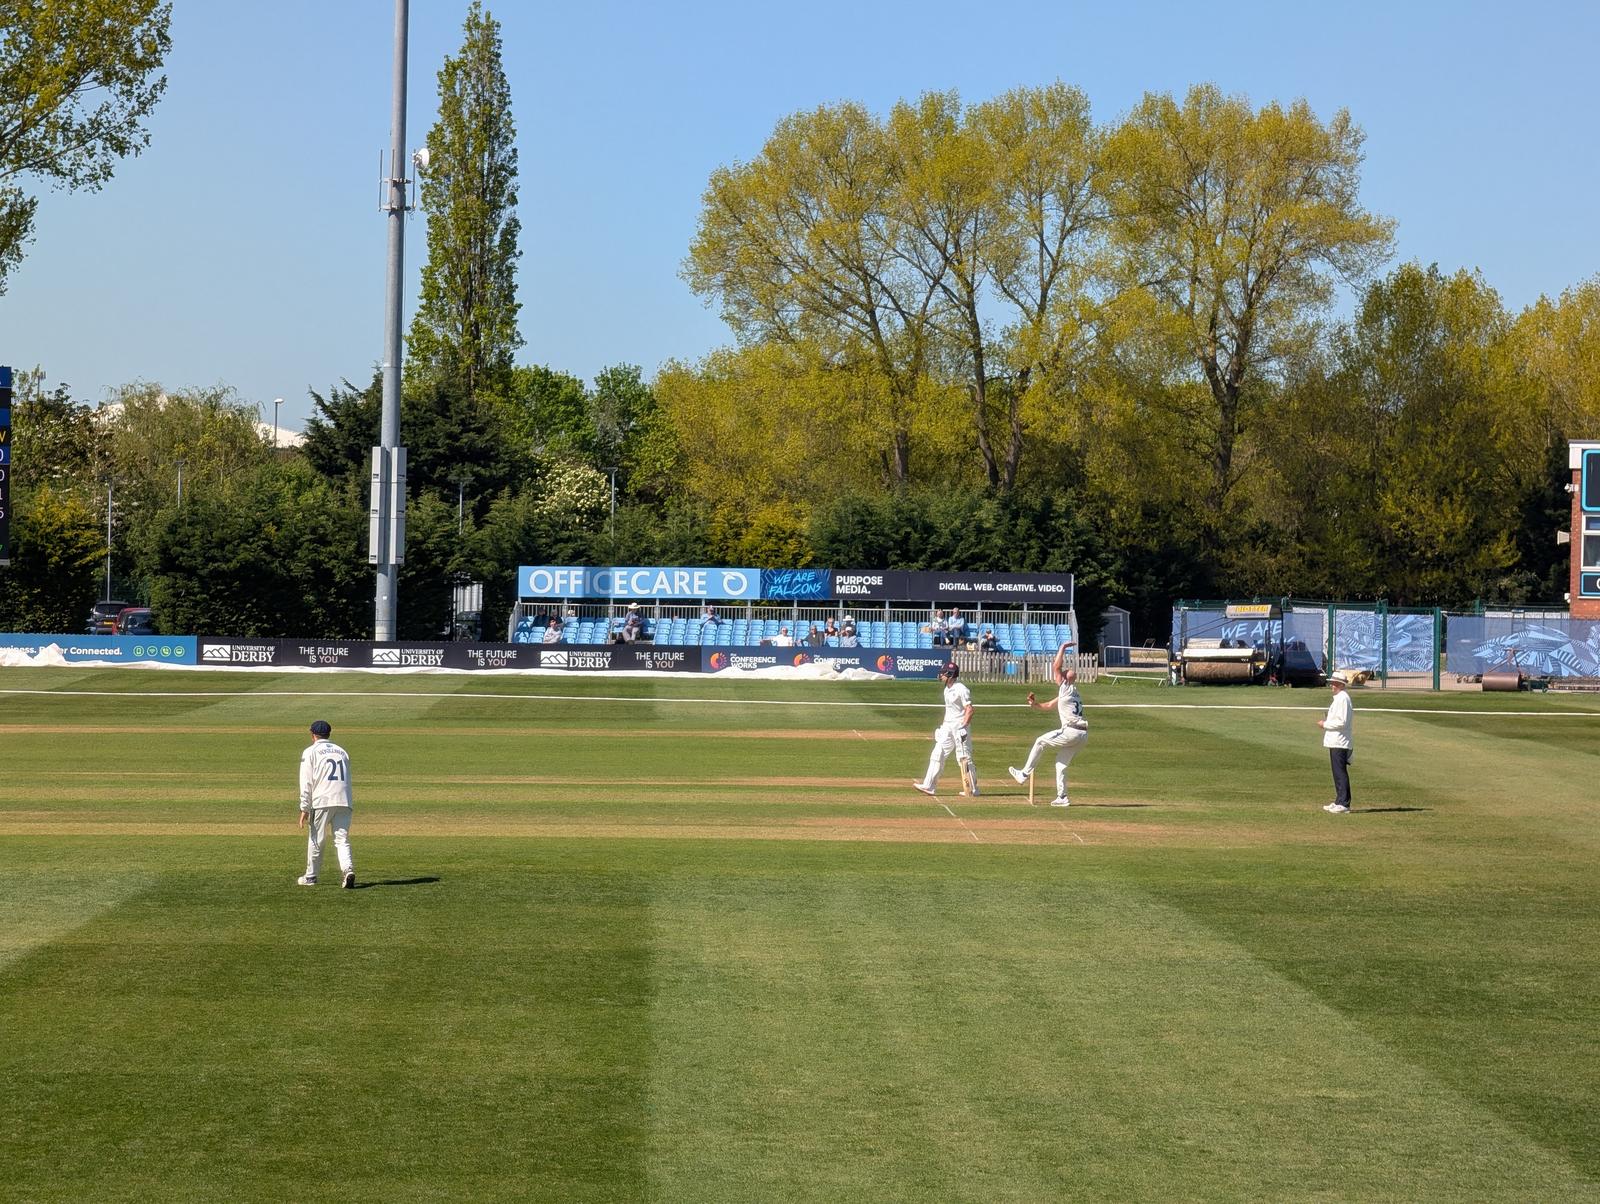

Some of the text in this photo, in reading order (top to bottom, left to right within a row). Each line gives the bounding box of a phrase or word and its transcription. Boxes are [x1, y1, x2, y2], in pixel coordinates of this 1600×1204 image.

[529, 569, 707, 595] OFFICECARE
[774, 571, 816, 584] WE ARE
[836, 575, 883, 585] PURPOSE
[768, 582, 822, 596] FALCONS
[836, 585, 871, 594] MEDIA.
[939, 583, 1065, 593] DIGITAL. WEB. CREATIVE. VIDEO.
[1221, 623, 1248, 638] WE
[70, 647, 122, 655] Connected.
[299, 646, 349, 656] THE FUTURE
[467, 650, 517, 659] THE FUTURE
[232, 651, 275, 662] DERBY
[309, 655, 338, 663] IS YOU
[401, 655, 444, 666] DERBY
[635, 652, 684, 661] THE FUTURE
[477, 658, 507, 666] IS YOU
[569, 657, 612, 668] DERBY
[645, 660, 674, 668] IS YOU
[326, 758, 345, 781] 21
